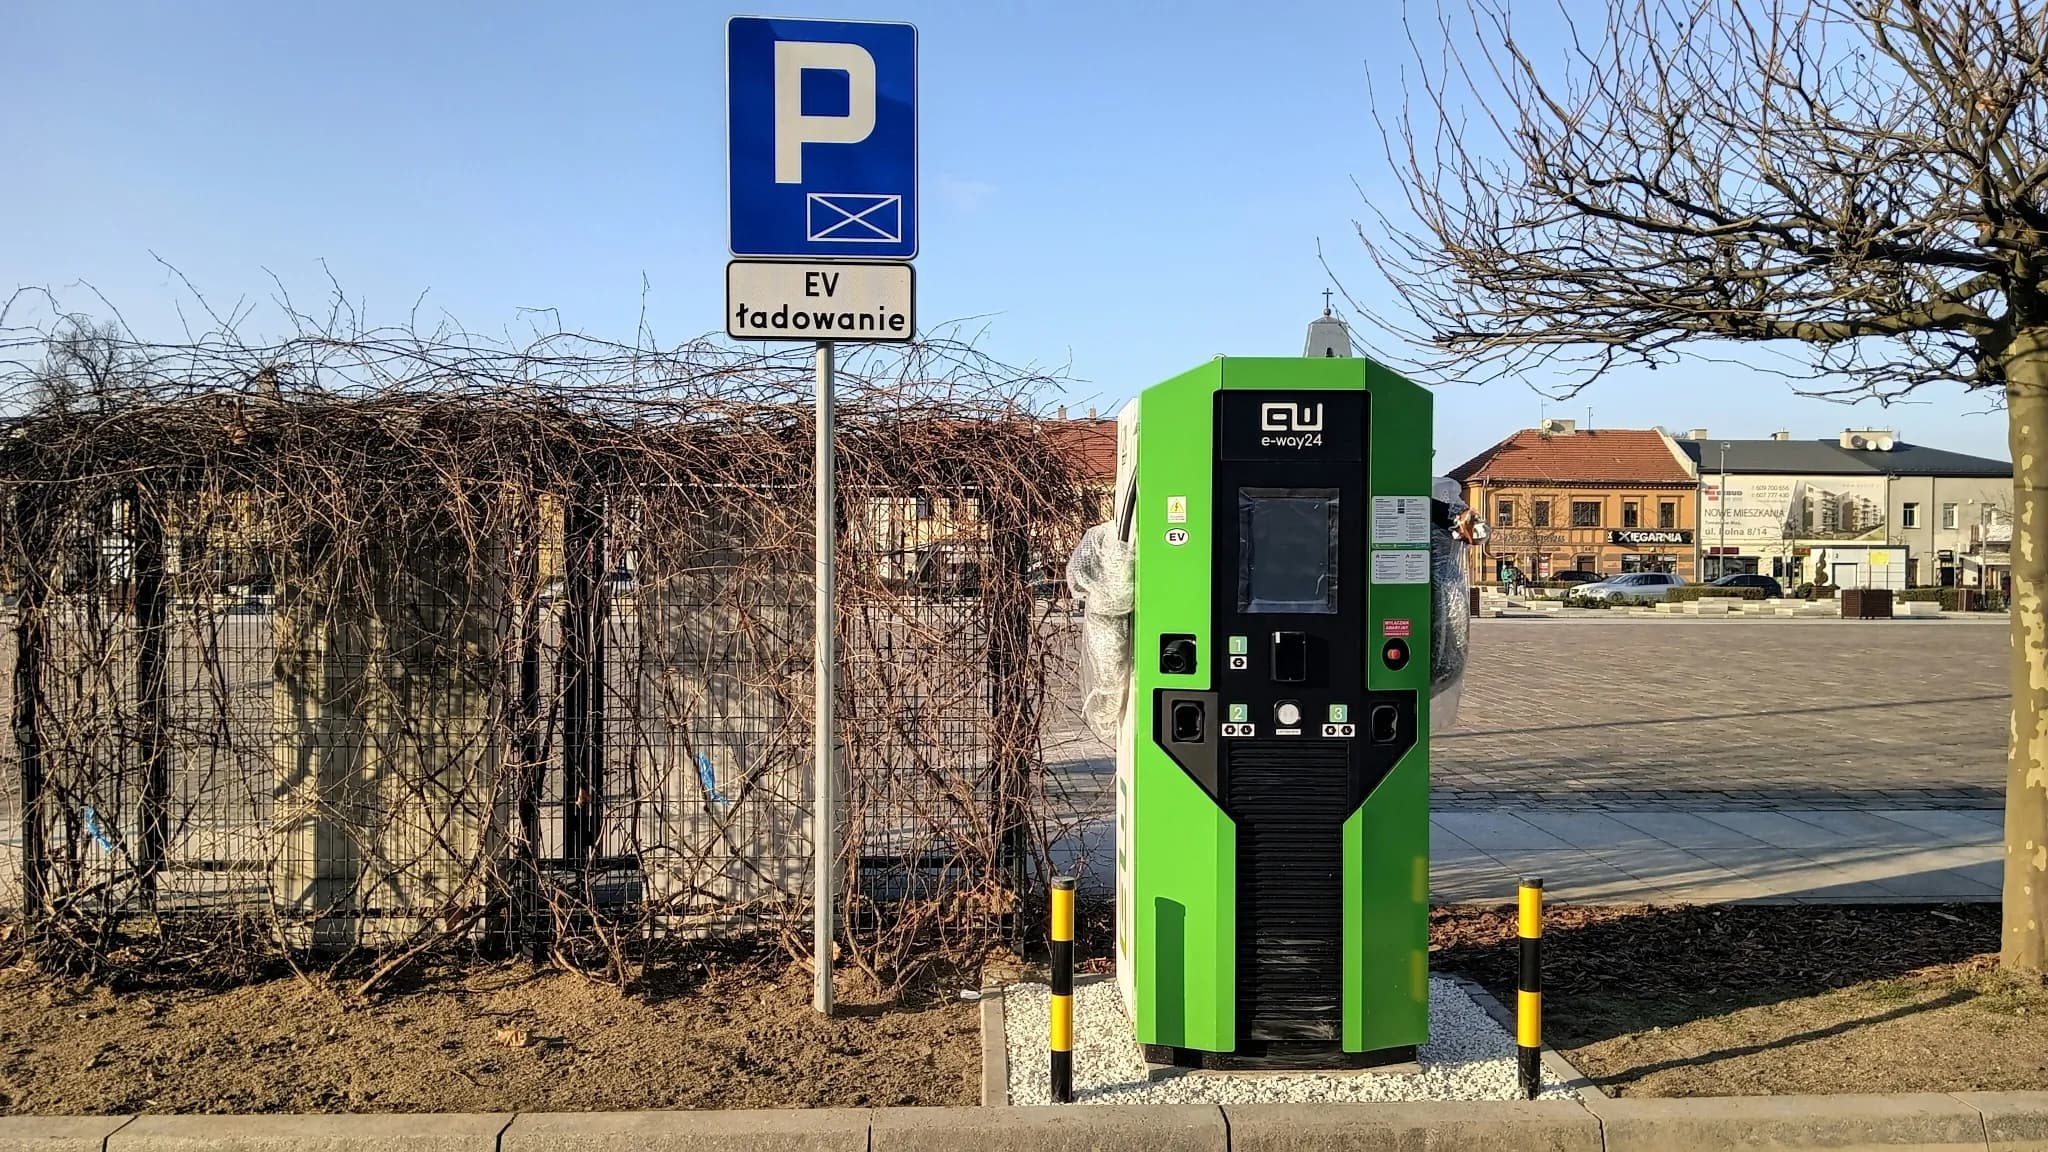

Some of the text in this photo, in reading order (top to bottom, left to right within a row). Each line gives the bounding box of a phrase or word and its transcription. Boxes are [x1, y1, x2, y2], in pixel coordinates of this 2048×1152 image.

[775, 41, 876, 184] P
[805, 271, 839, 297] EV
[736, 303, 905, 332] ładowanie
[1261, 433, 1322, 450] e-way24
[1704, 508, 1785, 518] NOWE MIESZKANIA
[1169, 533, 1185, 541] EV
[1705, 528, 1716, 536] ul.
[1747, 528, 1767, 536] 8/14
[1235, 639, 1241, 652] 1
[1234, 706, 1243, 720] 2
[1334, 707, 1343, 720] 3
